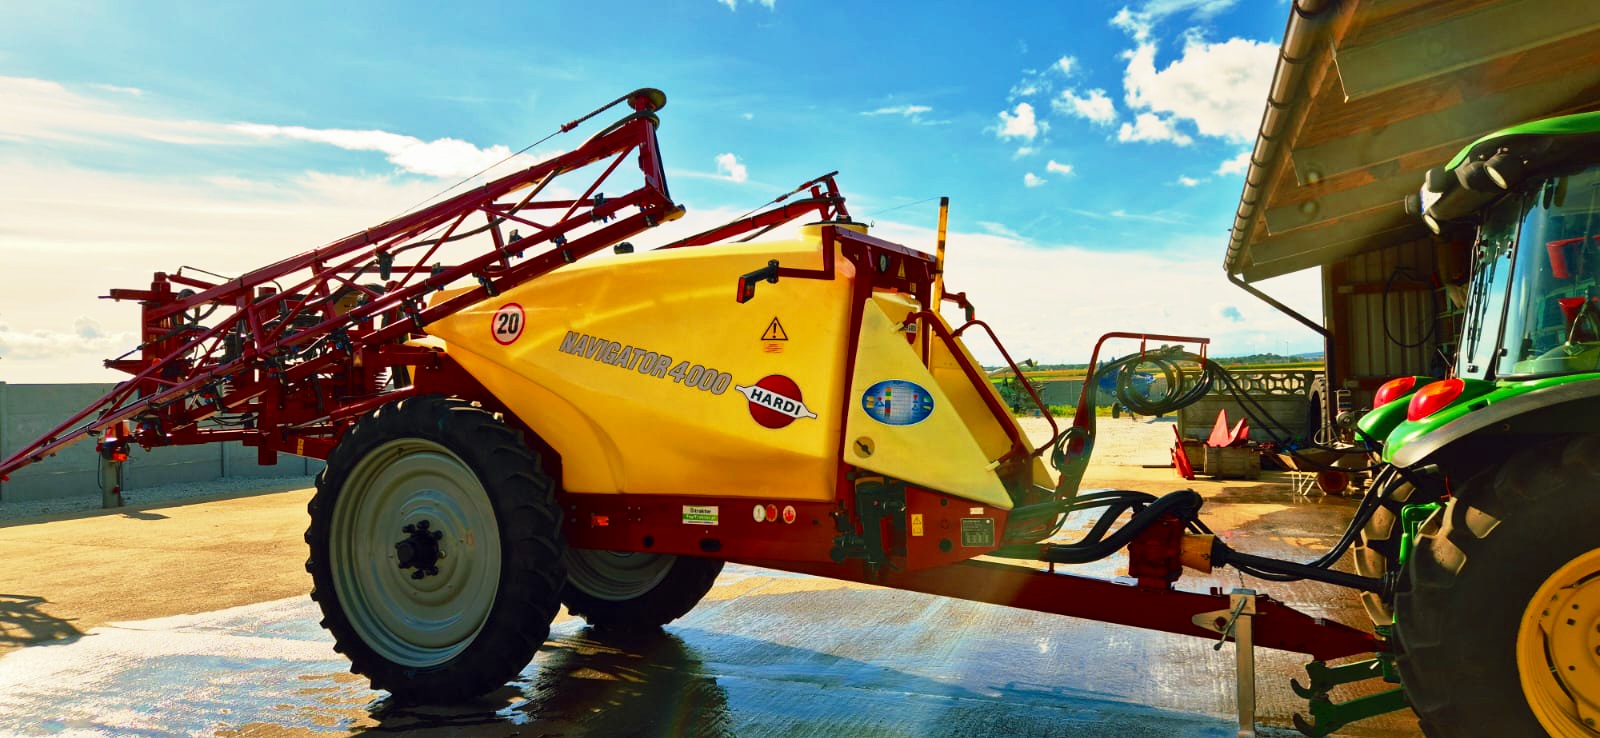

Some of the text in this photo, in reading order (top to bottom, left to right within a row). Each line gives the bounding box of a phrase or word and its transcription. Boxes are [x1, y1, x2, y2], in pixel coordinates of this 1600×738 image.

[497, 313, 519, 334] 20
[559, 331, 733, 395] NAVIGATOR 4000
[750, 389, 801, 415] HARDI
